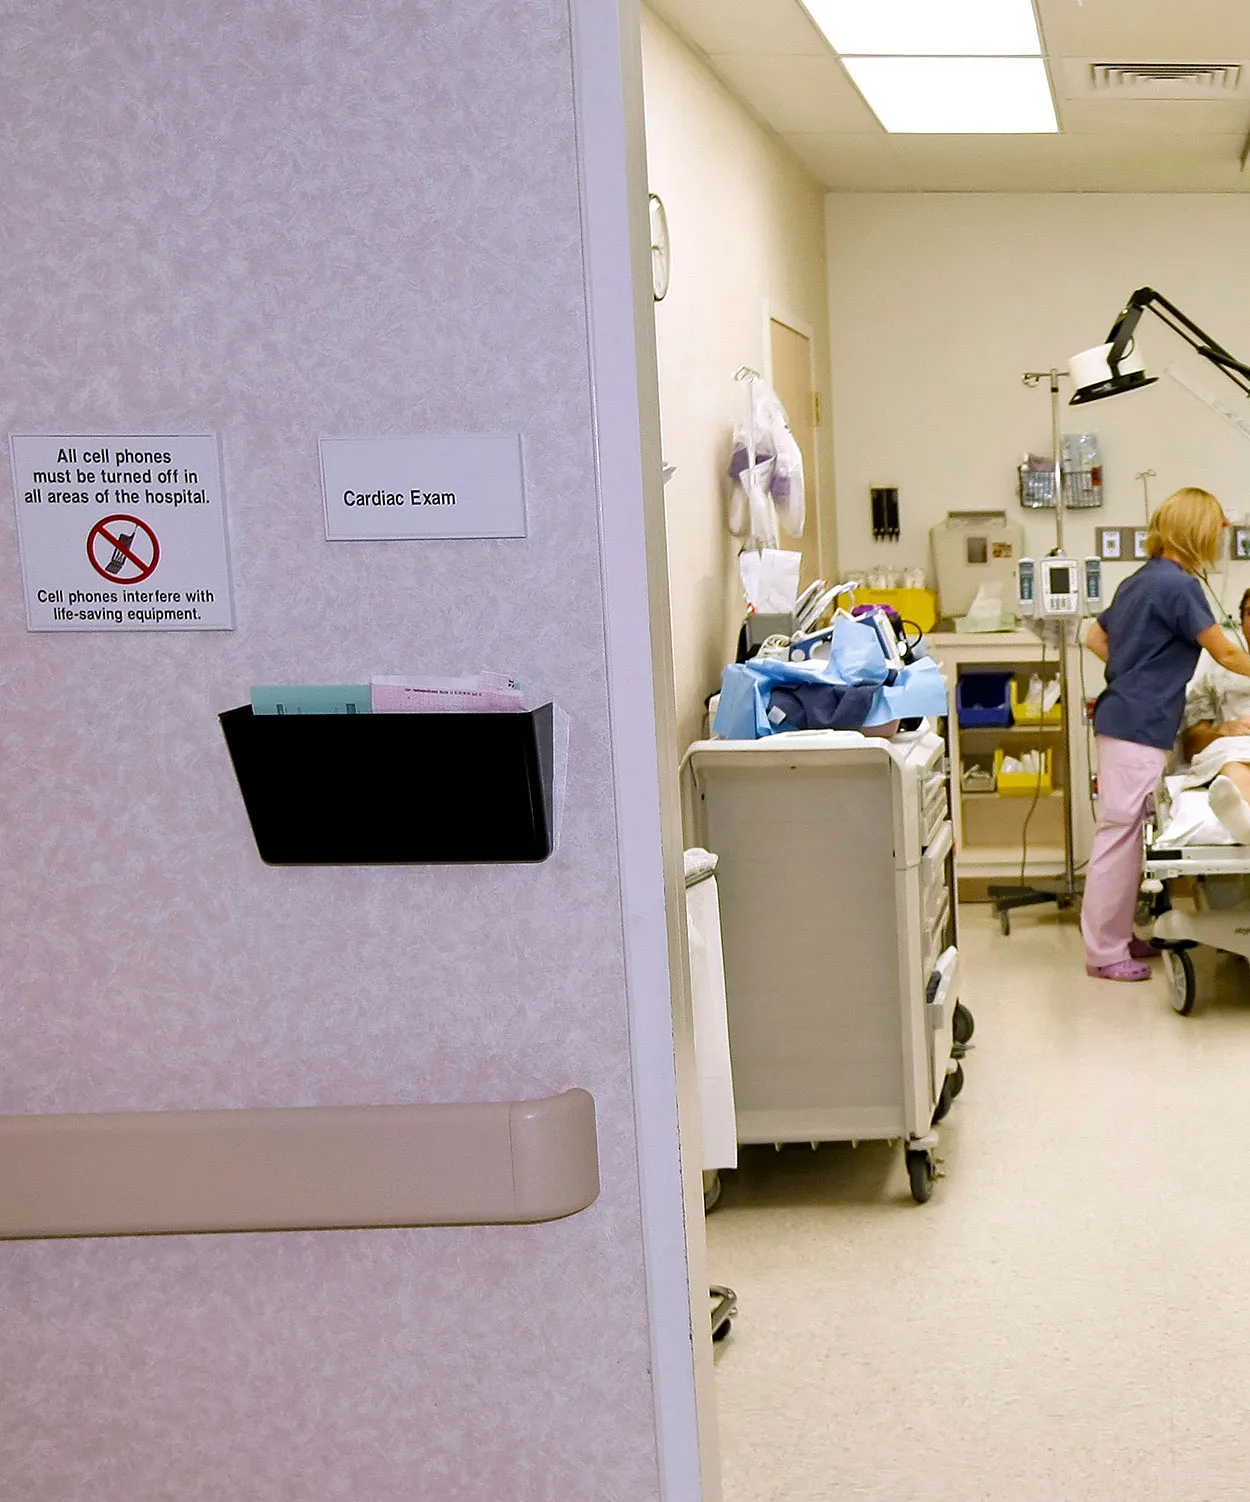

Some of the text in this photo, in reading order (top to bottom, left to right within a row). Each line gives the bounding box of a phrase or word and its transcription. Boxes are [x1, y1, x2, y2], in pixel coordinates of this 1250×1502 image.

[57, 448, 172, 467] All cell phones
[33, 469, 198, 483] must be turned off in
[24, 489, 210, 507] all areas of the hospital.
[343, 489, 456, 507] Cardiac Exam
[37, 589, 214, 605] Cell phones interfere with
[53, 607, 202, 623] life-saving equipment.
